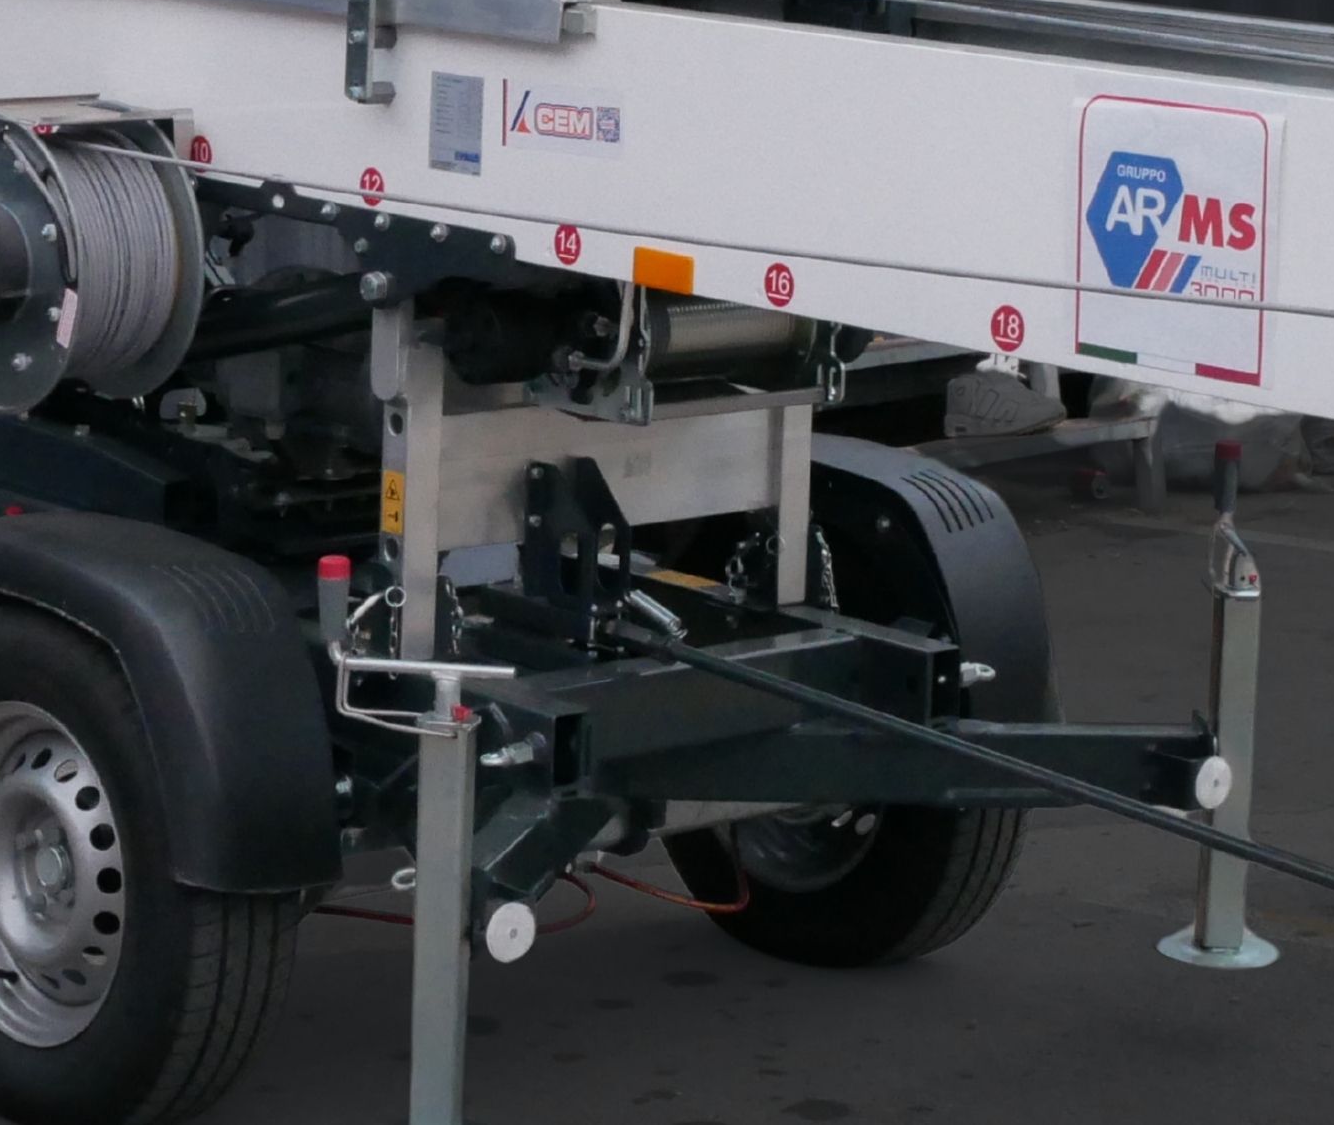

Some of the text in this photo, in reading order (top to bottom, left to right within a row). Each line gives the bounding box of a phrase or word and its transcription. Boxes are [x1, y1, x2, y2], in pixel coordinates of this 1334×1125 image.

[536, 105, 592, 138] CEM
[194, 141, 209, 162] 10
[363, 173, 381, 193] 12
[1116, 163, 1167, 183] GRUPPO
[557, 230, 577, 254] 14
[768, 269, 790, 295] 16
[1200, 265, 1257, 284] MULTI
[996, 312, 1020, 339] 18
